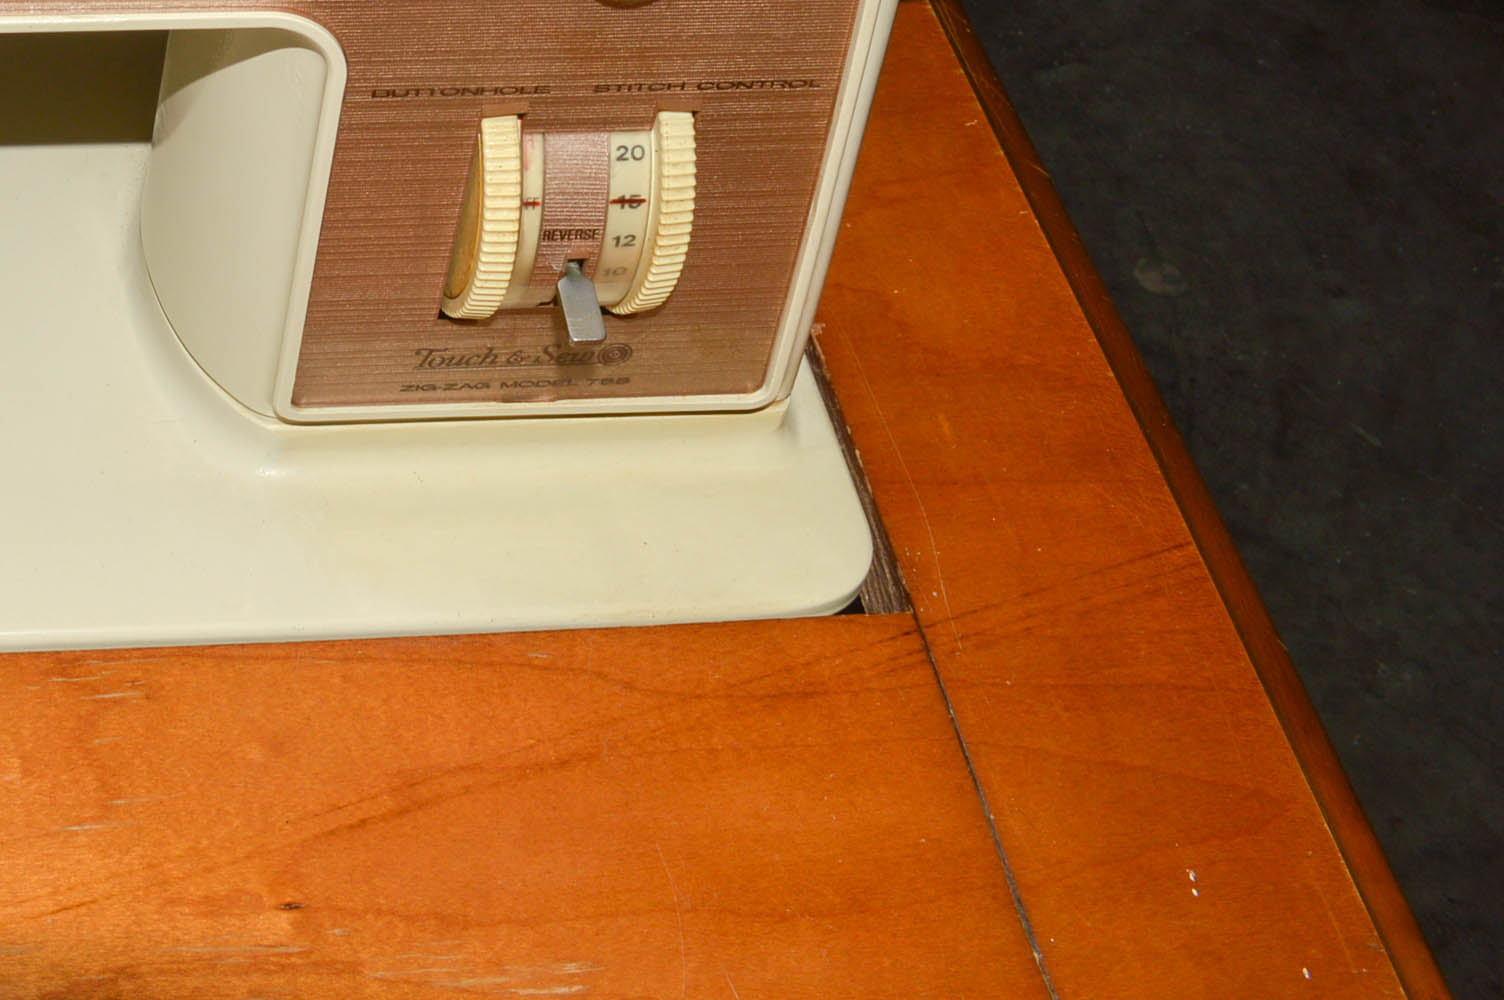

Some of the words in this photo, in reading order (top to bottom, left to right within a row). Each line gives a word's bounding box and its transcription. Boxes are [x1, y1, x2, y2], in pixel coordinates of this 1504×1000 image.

[370, 84, 552, 98] BUTTONHOLE
[594, 82, 686, 93] STITCH
[695, 79, 821, 90] CONTROL
[615, 144, 645, 161] 20
[616, 194, 643, 210] 15
[542, 228, 600, 241] REVERSE
[612, 233, 637, 248] 12
[602, 266, 628, 277] 10
[414, 346, 496, 370] Touch
[534, 344, 595, 365] Sew
[399, 382, 491, 392] ZIG-ZAG
[499, 378, 577, 389] MODEL
